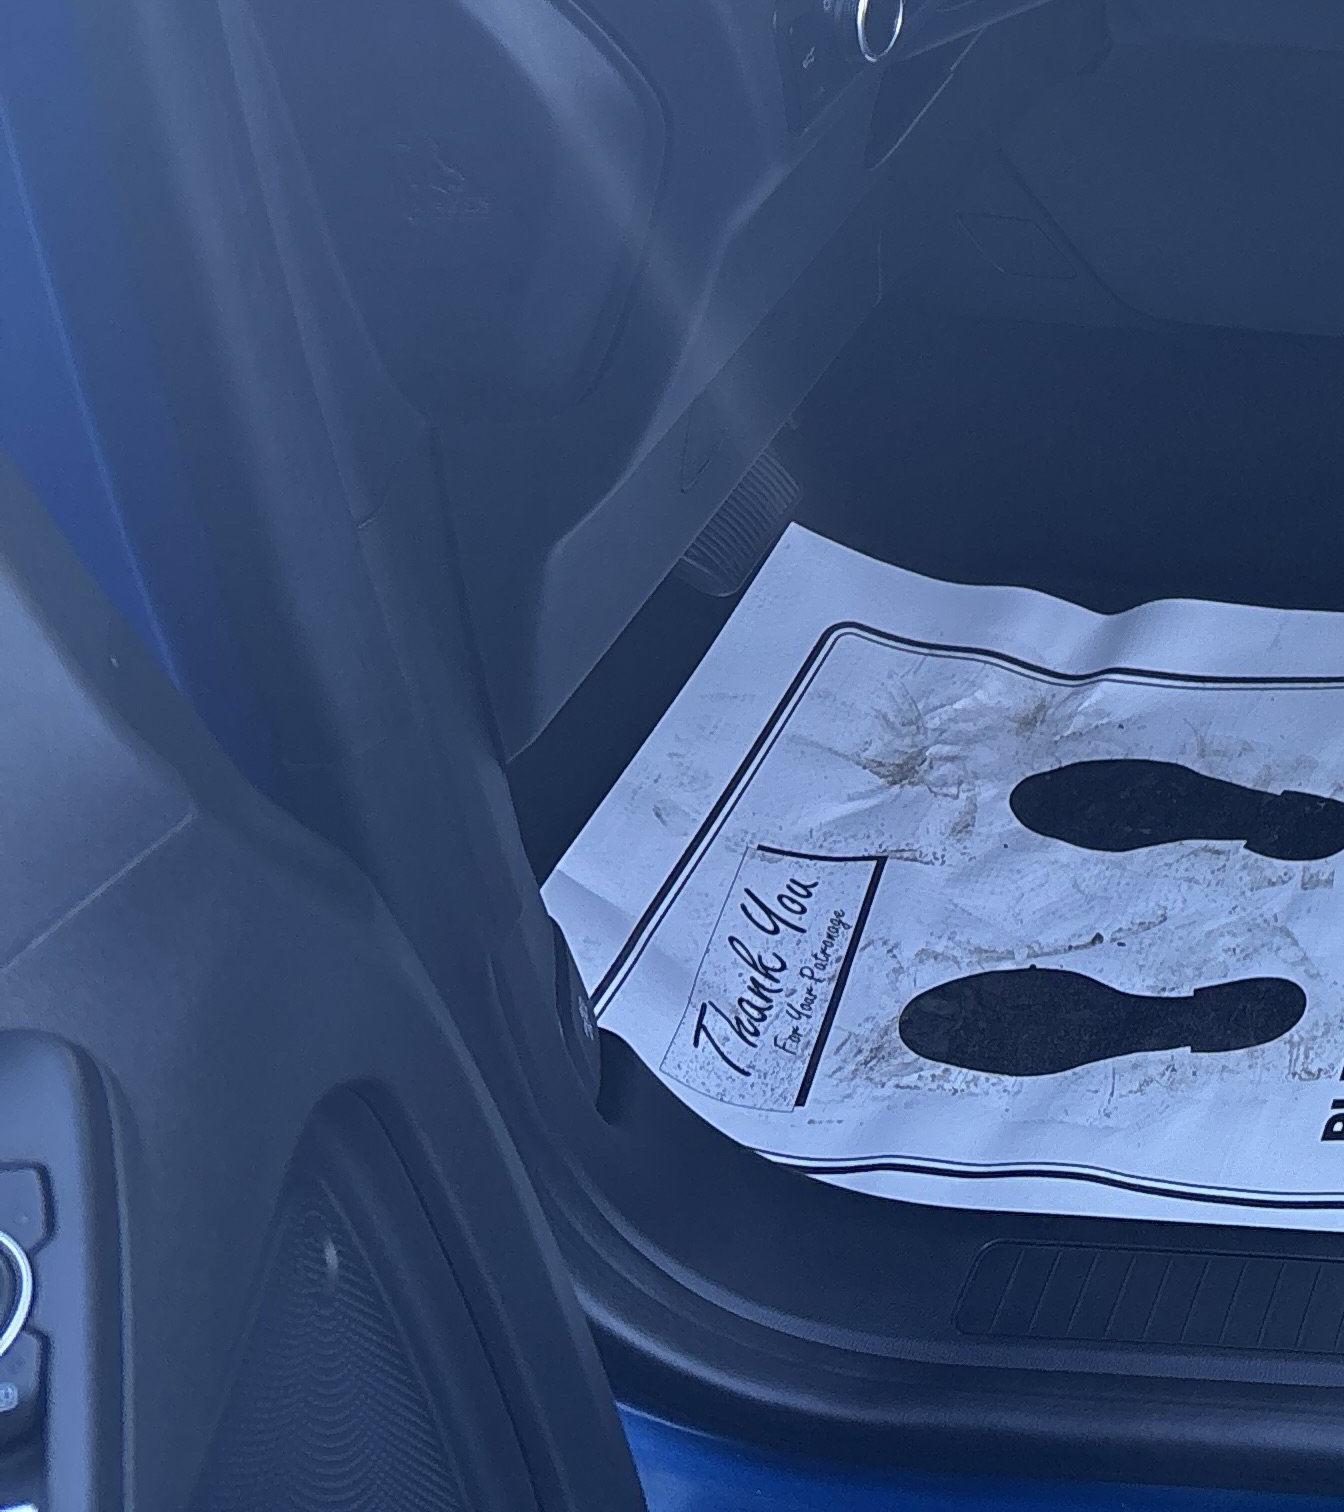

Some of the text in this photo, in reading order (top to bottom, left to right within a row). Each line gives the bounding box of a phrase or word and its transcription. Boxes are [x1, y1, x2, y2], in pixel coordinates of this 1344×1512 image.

[693, 878, 819, 1076] Thank You
[773, 909, 853, 1056] For Your Patronage
